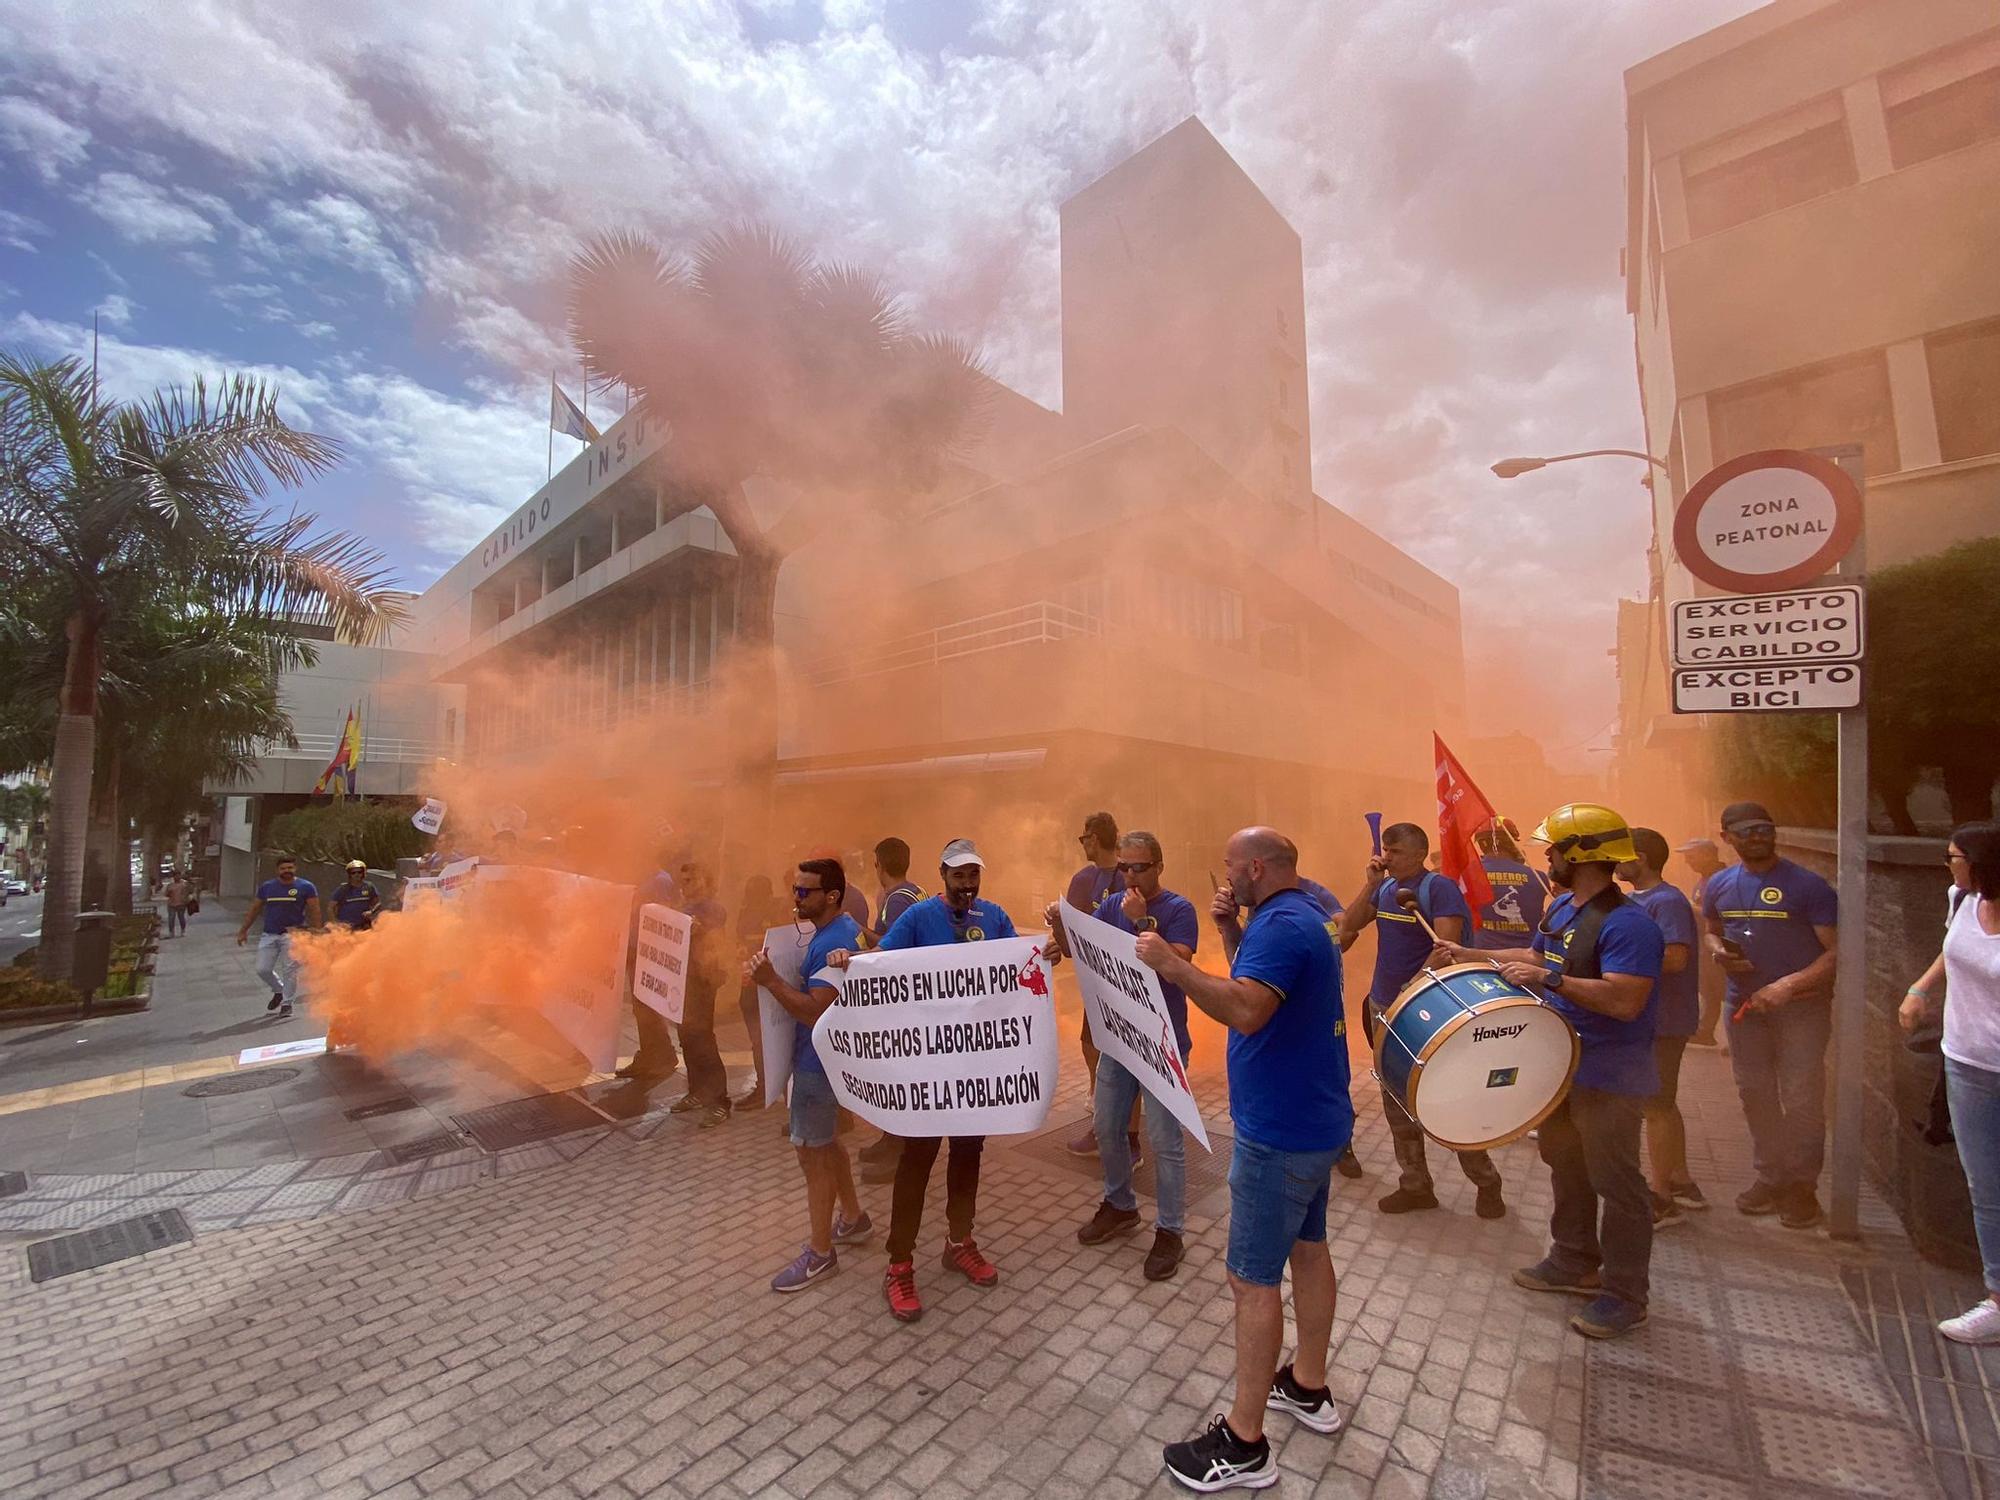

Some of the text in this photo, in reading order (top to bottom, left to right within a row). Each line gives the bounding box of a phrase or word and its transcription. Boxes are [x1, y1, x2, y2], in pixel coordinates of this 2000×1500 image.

[1741, 497, 1799, 518] ZONA
[483, 497, 550, 568] CABILDO
[1716, 519, 1828, 547] PEATONAL
[1686, 595, 1845, 619] EXCEPTO
[1686, 617, 1848, 640] SERVICIO
[1691, 640, 1841, 660] CABILDO
[1681, 667, 1854, 689] EXCEPTO
[1730, 691, 1800, 708] BICI
[1487, 871, 1528, 883] MBEROS
[834, 963, 1018, 1008] OMBEROS EN LUCHA POR
[1114, 957, 1157, 1014] ACATE
[827, 1015, 1033, 1060] LOS DRECHOS LABORABLES Y
[842, 1065, 1040, 1111] SEGURIDAD DE LA POBLACIÓN
